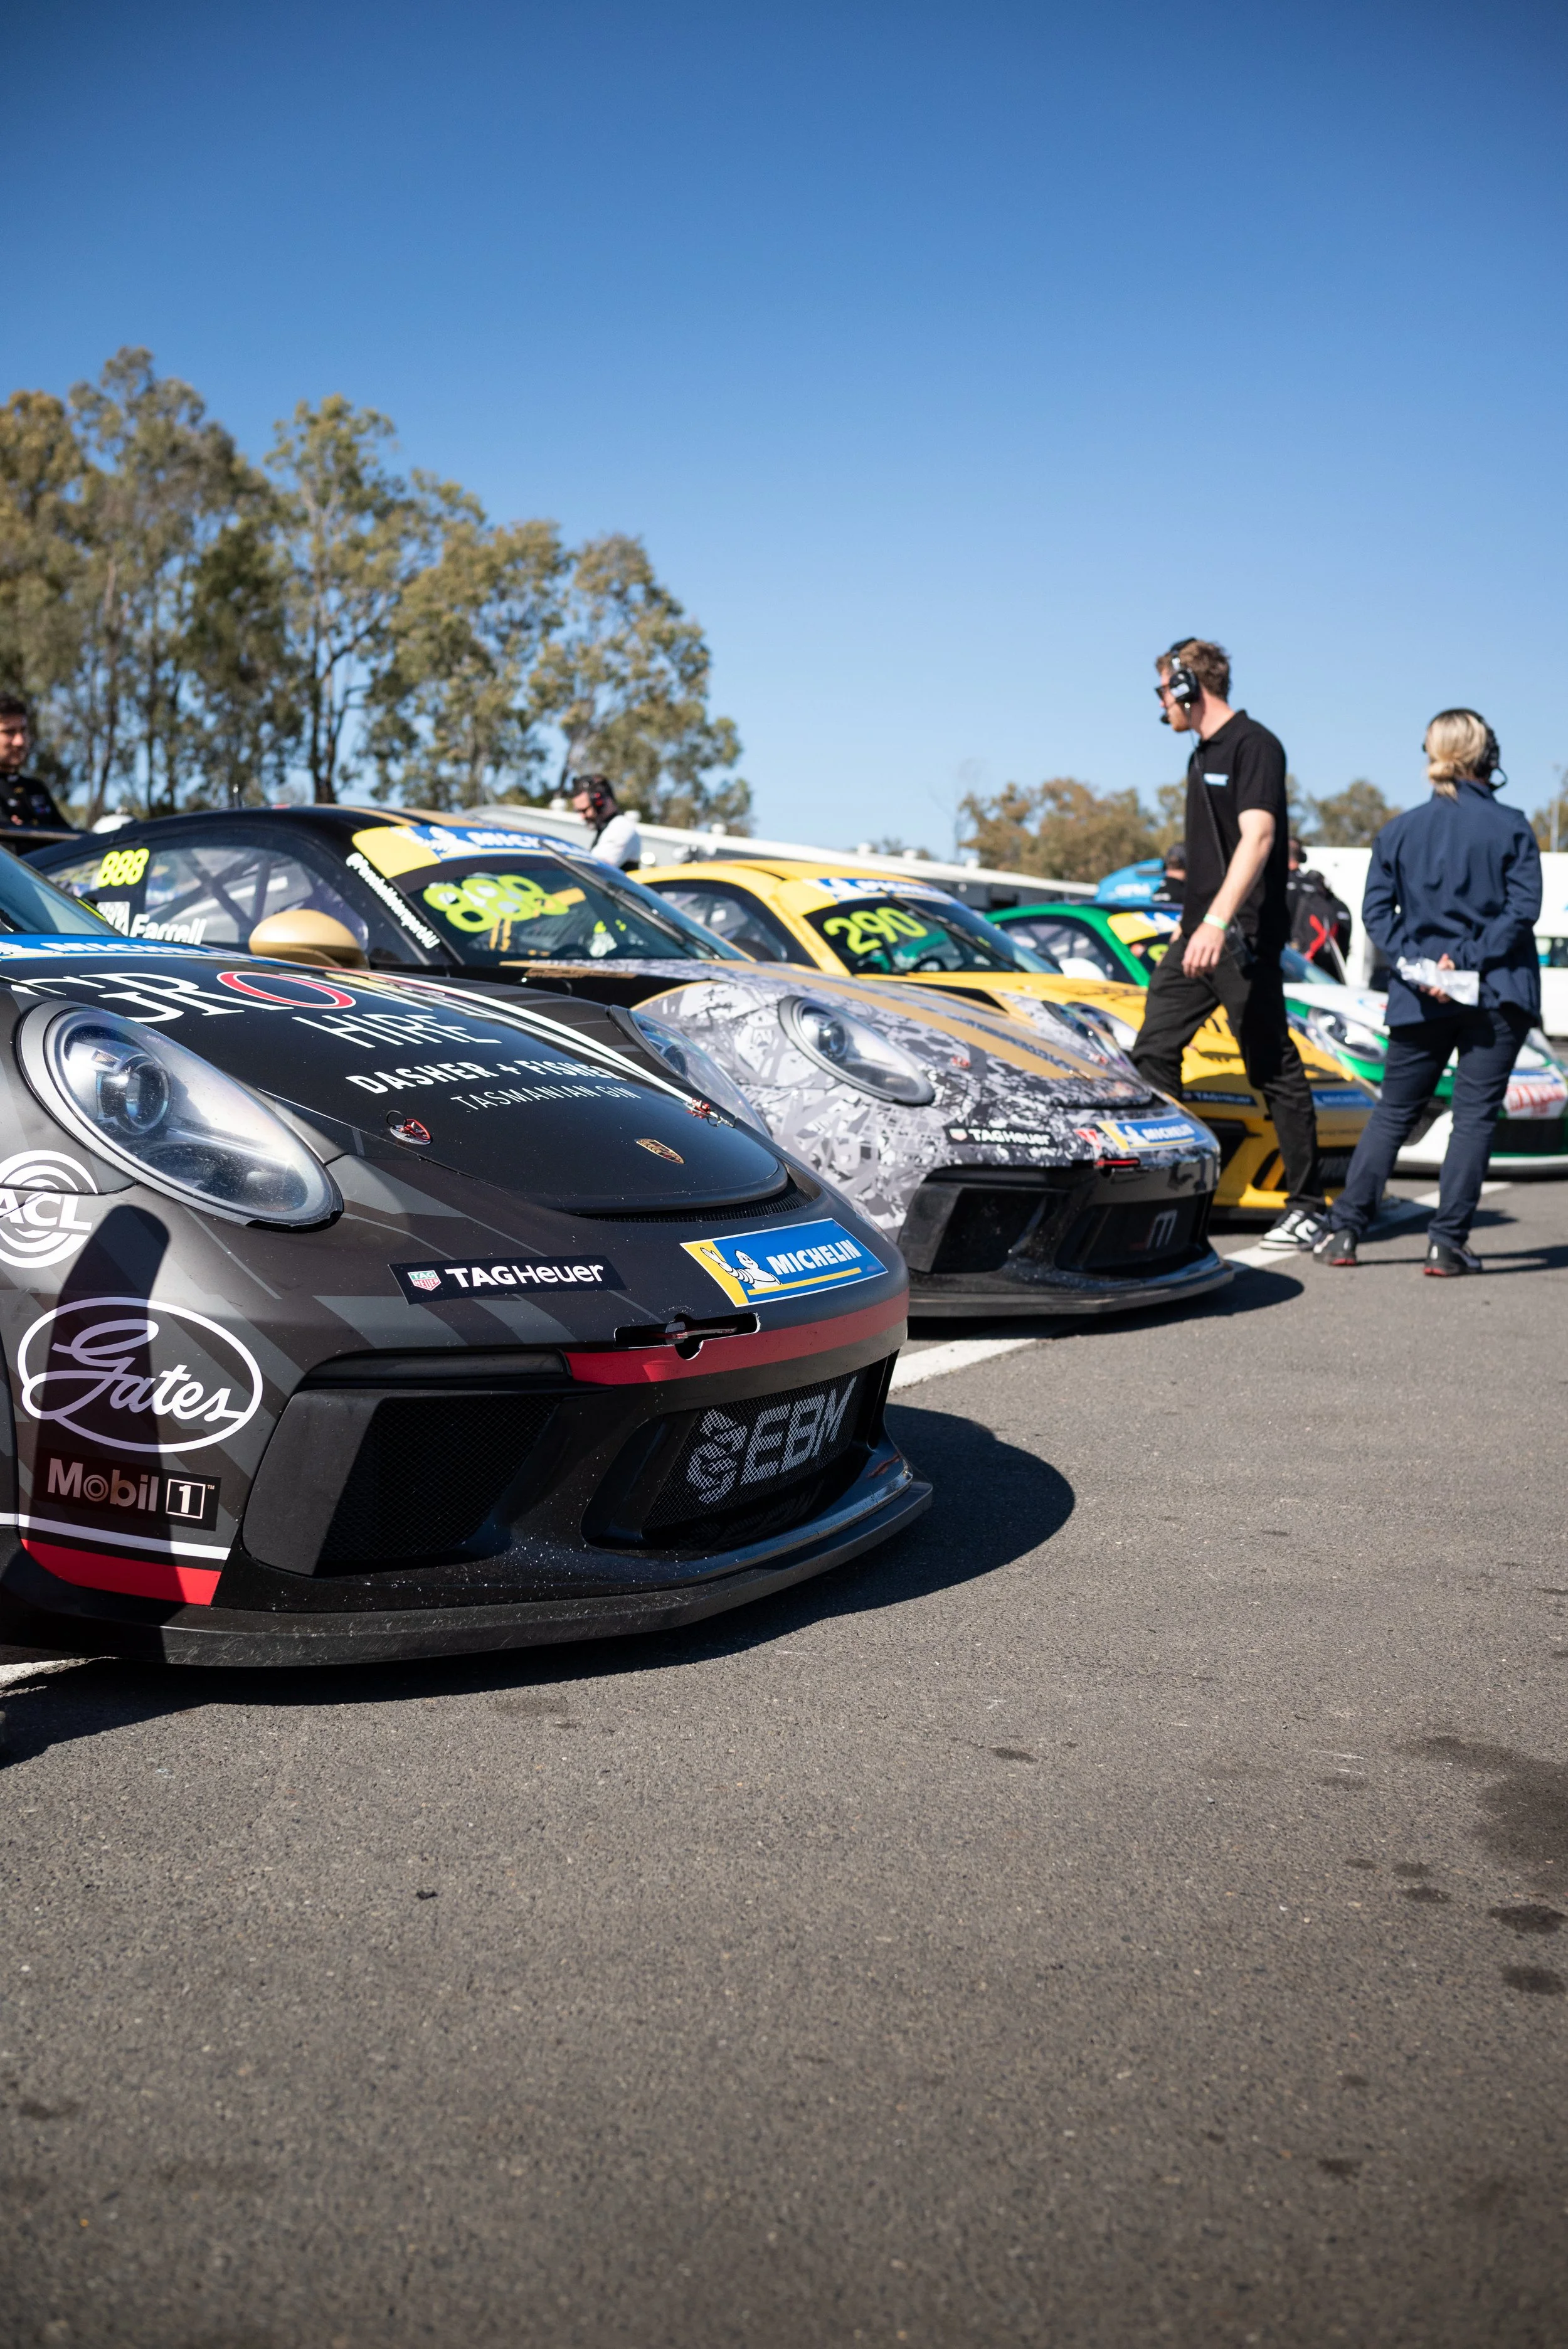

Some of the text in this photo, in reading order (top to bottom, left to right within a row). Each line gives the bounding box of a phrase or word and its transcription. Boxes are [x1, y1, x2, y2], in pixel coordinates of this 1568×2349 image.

[97, 848, 149, 888] 888
[423, 874, 569, 933] 888
[129, 914, 207, 945] Farrell
[823, 907, 928, 955] 290
[292, 1014, 502, 1048] HIRE
[345, 1062, 499, 1094] DASHER
[514, 1060, 627, 1081] FISHER
[450, 1085, 642, 1110] TASMANIAN GIN
[0, 1189, 92, 1231] ACL
[410, 1271, 437, 1280] TAG
[766, 1239, 862, 1275] MICHELIN
[414, 1278, 440, 1290] HEUER
[22, 1319, 245, 1423] Gates
[740, 1376, 857, 1486] EBM
[48, 1458, 159, 1512] Mobil
